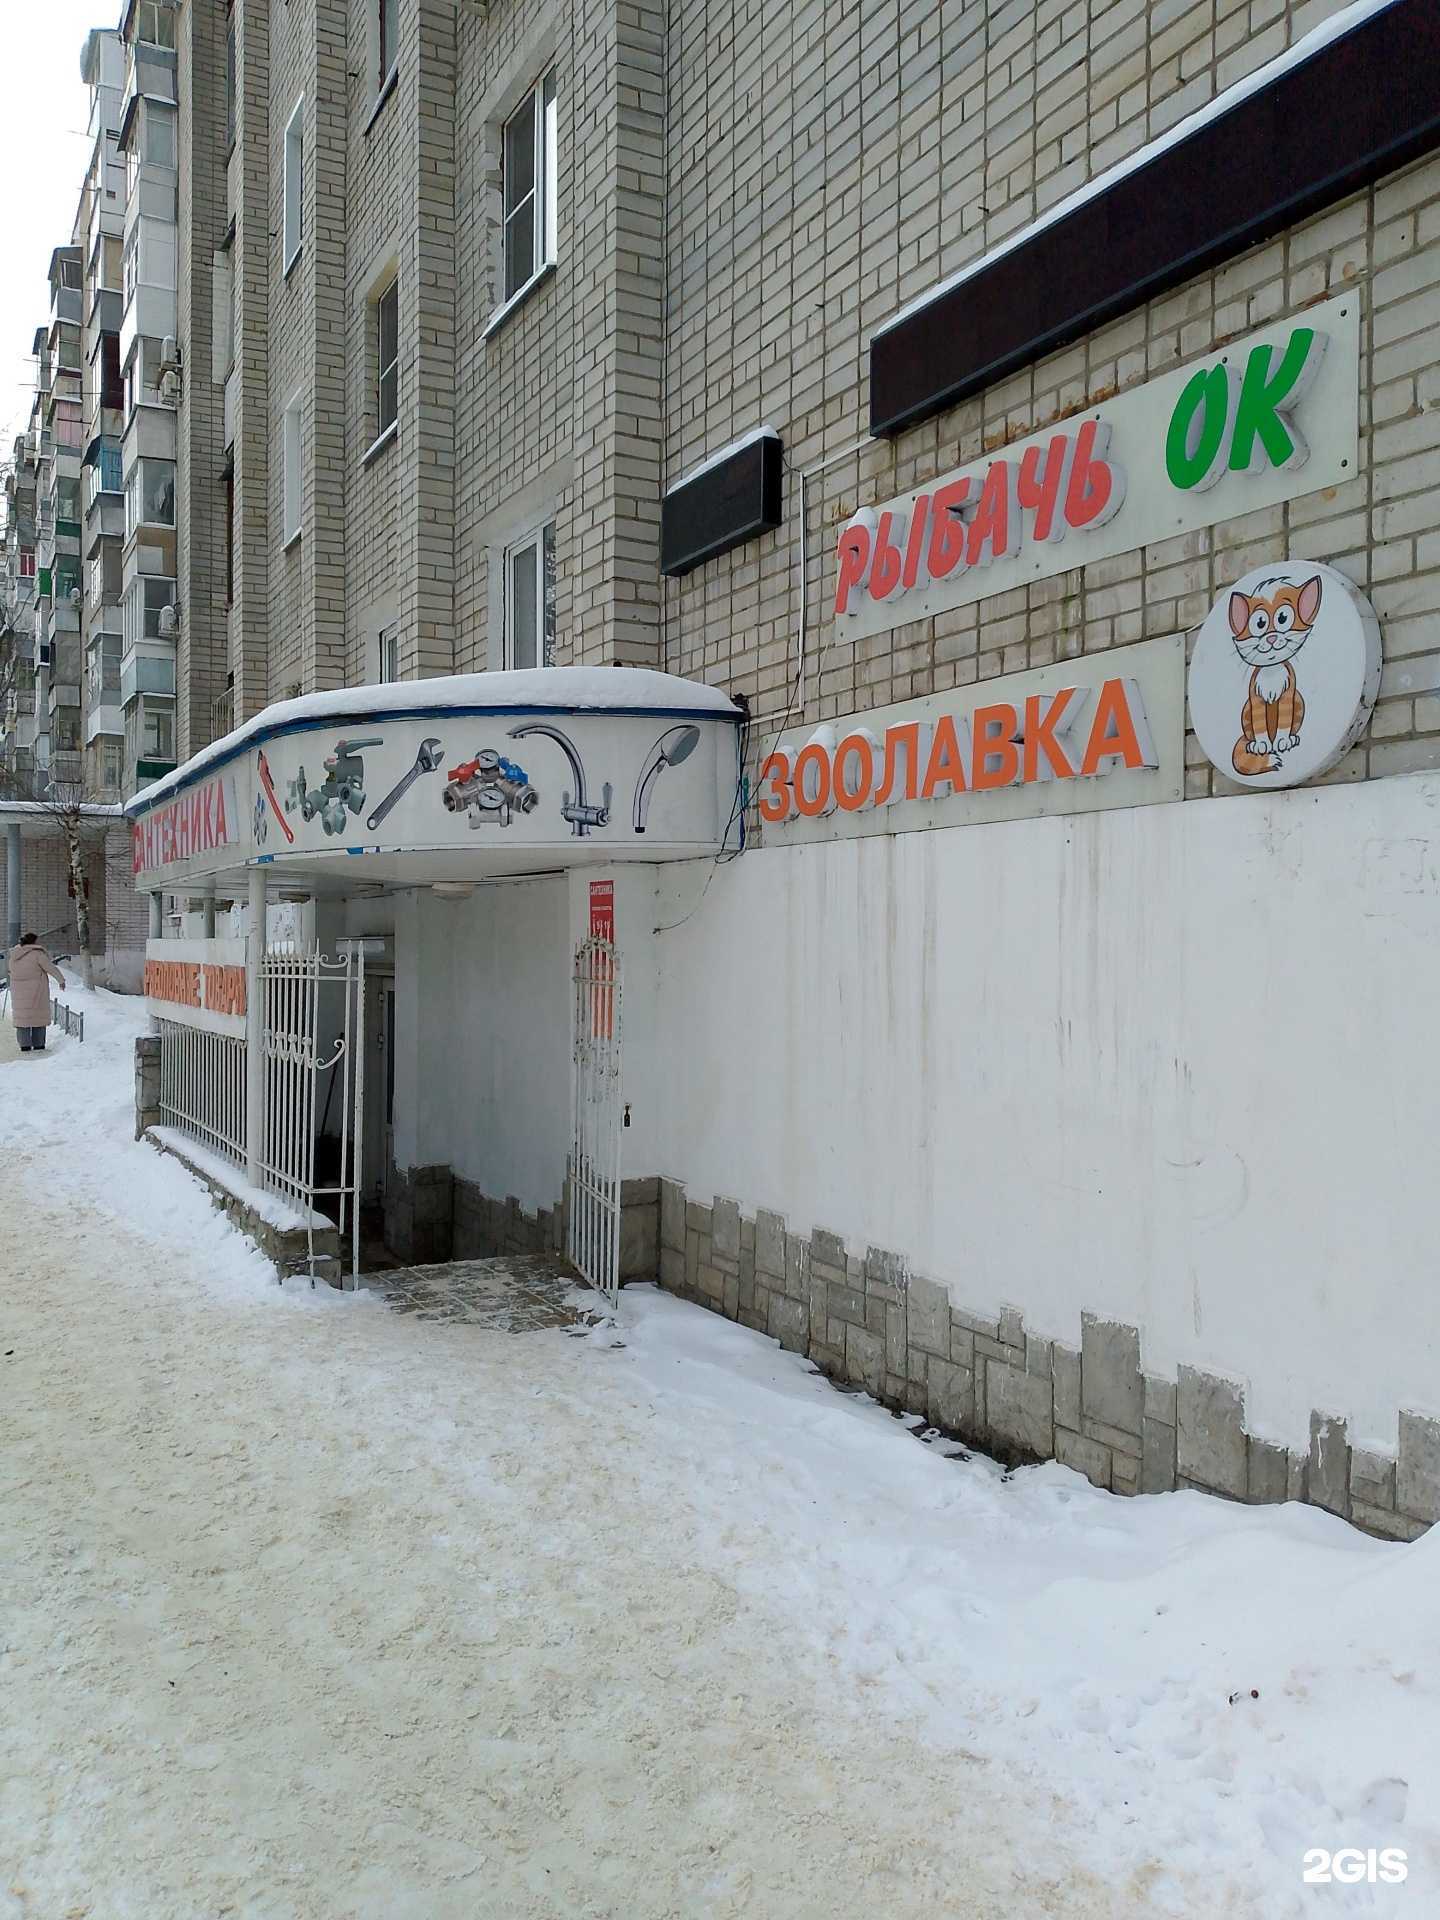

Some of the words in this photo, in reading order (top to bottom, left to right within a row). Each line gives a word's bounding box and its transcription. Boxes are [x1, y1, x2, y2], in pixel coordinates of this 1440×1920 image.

[834, 420, 1116, 615] РЫБАЧЬ
[1165, 328, 1317, 490] ОК
[759, 678, 1145, 824] ЗООЛАВКА
[132, 777, 228, 873] САНТЕХНИКА
